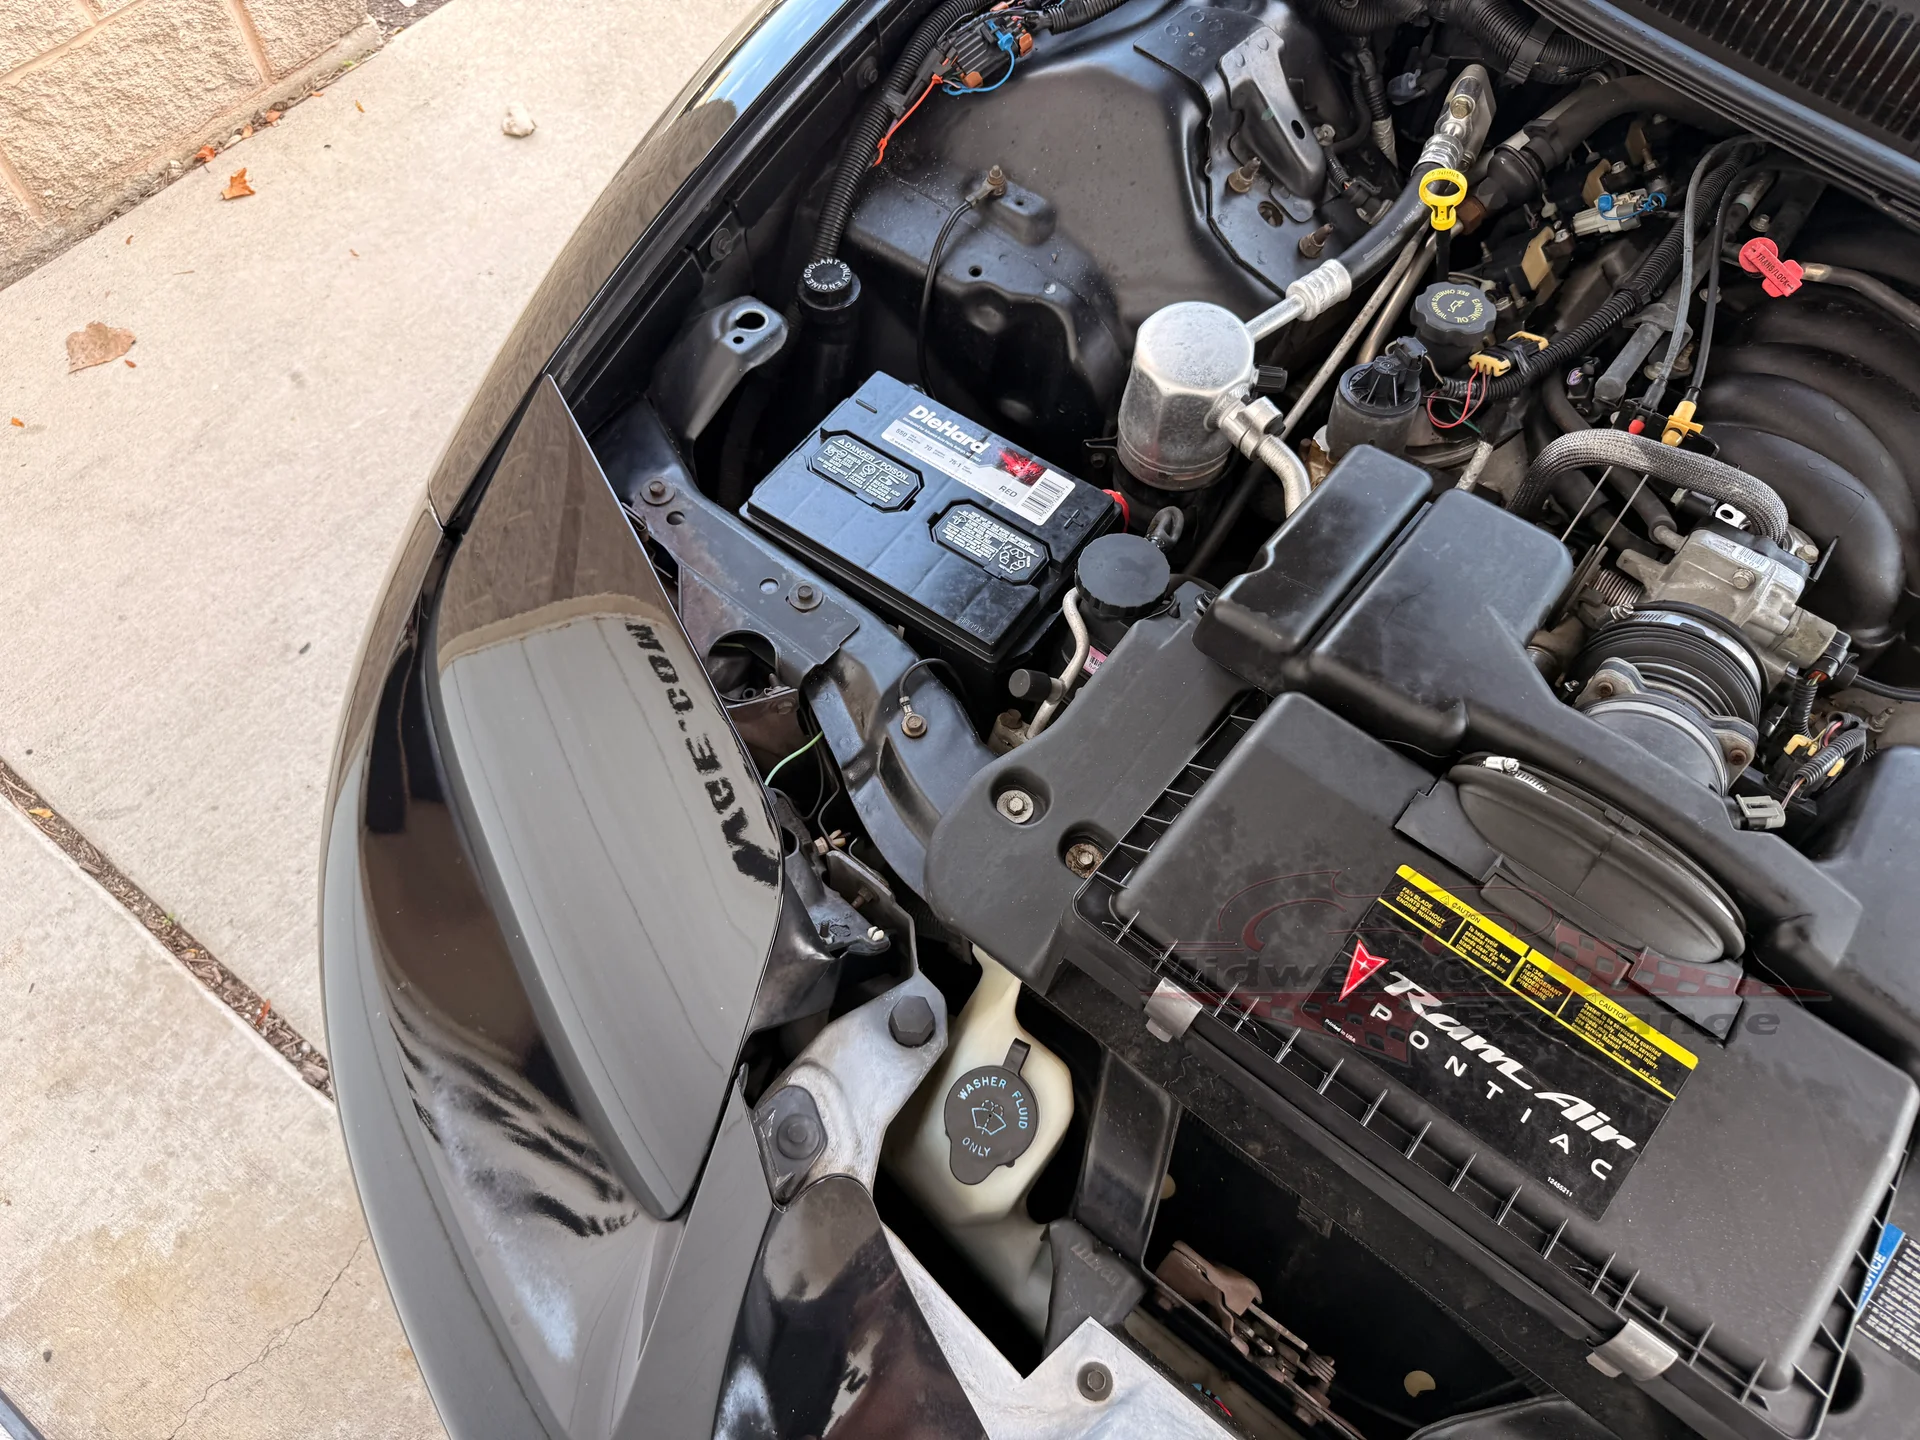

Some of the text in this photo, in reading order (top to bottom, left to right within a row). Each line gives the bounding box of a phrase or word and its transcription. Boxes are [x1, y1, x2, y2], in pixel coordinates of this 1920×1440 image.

[803, 256, 851, 290] ENGINE COOLANT ONLY
[1754, 252, 1791, 286] TRANS/LOCK
[1431, 301, 1446, 319] MANUAL
[1467, 298, 1483, 320] ENGINE
[908, 404, 990, 455] DieHard
[844, 441, 875, 462] DANGER
[880, 461, 908, 480] POISON
[997, 483, 1017, 499] RED
[1395, 895, 1442, 929] ENGINE RUNNING
[1398, 890, 1445, 924] STARTS WITHOUT
[1401, 886, 1433, 909] FAN BLADE
[1451, 901, 1481, 923] CAUTION
[1455, 943, 1468, 954] time.
[1461, 934, 1476, 947] hands
[1488, 952, 1499, 962] Fan
[1464, 929, 1511, 964] personal injury, keep
[1473, 929, 1485, 939] help
[1483, 936, 1498, 948] avoid
[1458, 939, 1472, 951] blade
[1471, 947, 1481, 957] can
[1479, 953, 1492, 964] start
[1495, 964, 1506, 974] any
[1525, 963, 1544, 978] R-134a
[1515, 977, 1547, 1000] PRESSURE
[1518, 972, 1555, 999] UNDER HIGH
[1521, 967, 1562, 997] REFRIGERANT
[1597, 998, 1629, 1022] CAUTION
[1323, 1018, 1341, 1032] Printed
[1344, 1032, 1357, 1043] USA
[1574, 1016, 1622, 1051] See Service Manual.
[1576, 1012, 1659, 1070] methods may cause personal injury.
[1580, 1007, 1657, 1061] personnel only. Improper service
[1582, 1002, 1661, 1058] System to be serviced by qualified
[1384, 968, 1637, 1150] Ram Air
[1638, 1067, 1649, 1076] SAE
[957, 1076, 1028, 1130] WASHER FLUID
[1369, 1002, 1613, 1181] PONTIAC
[962, 1137, 991, 1157] ONLY
[1545, 1175, 1573, 1197] 12455211
